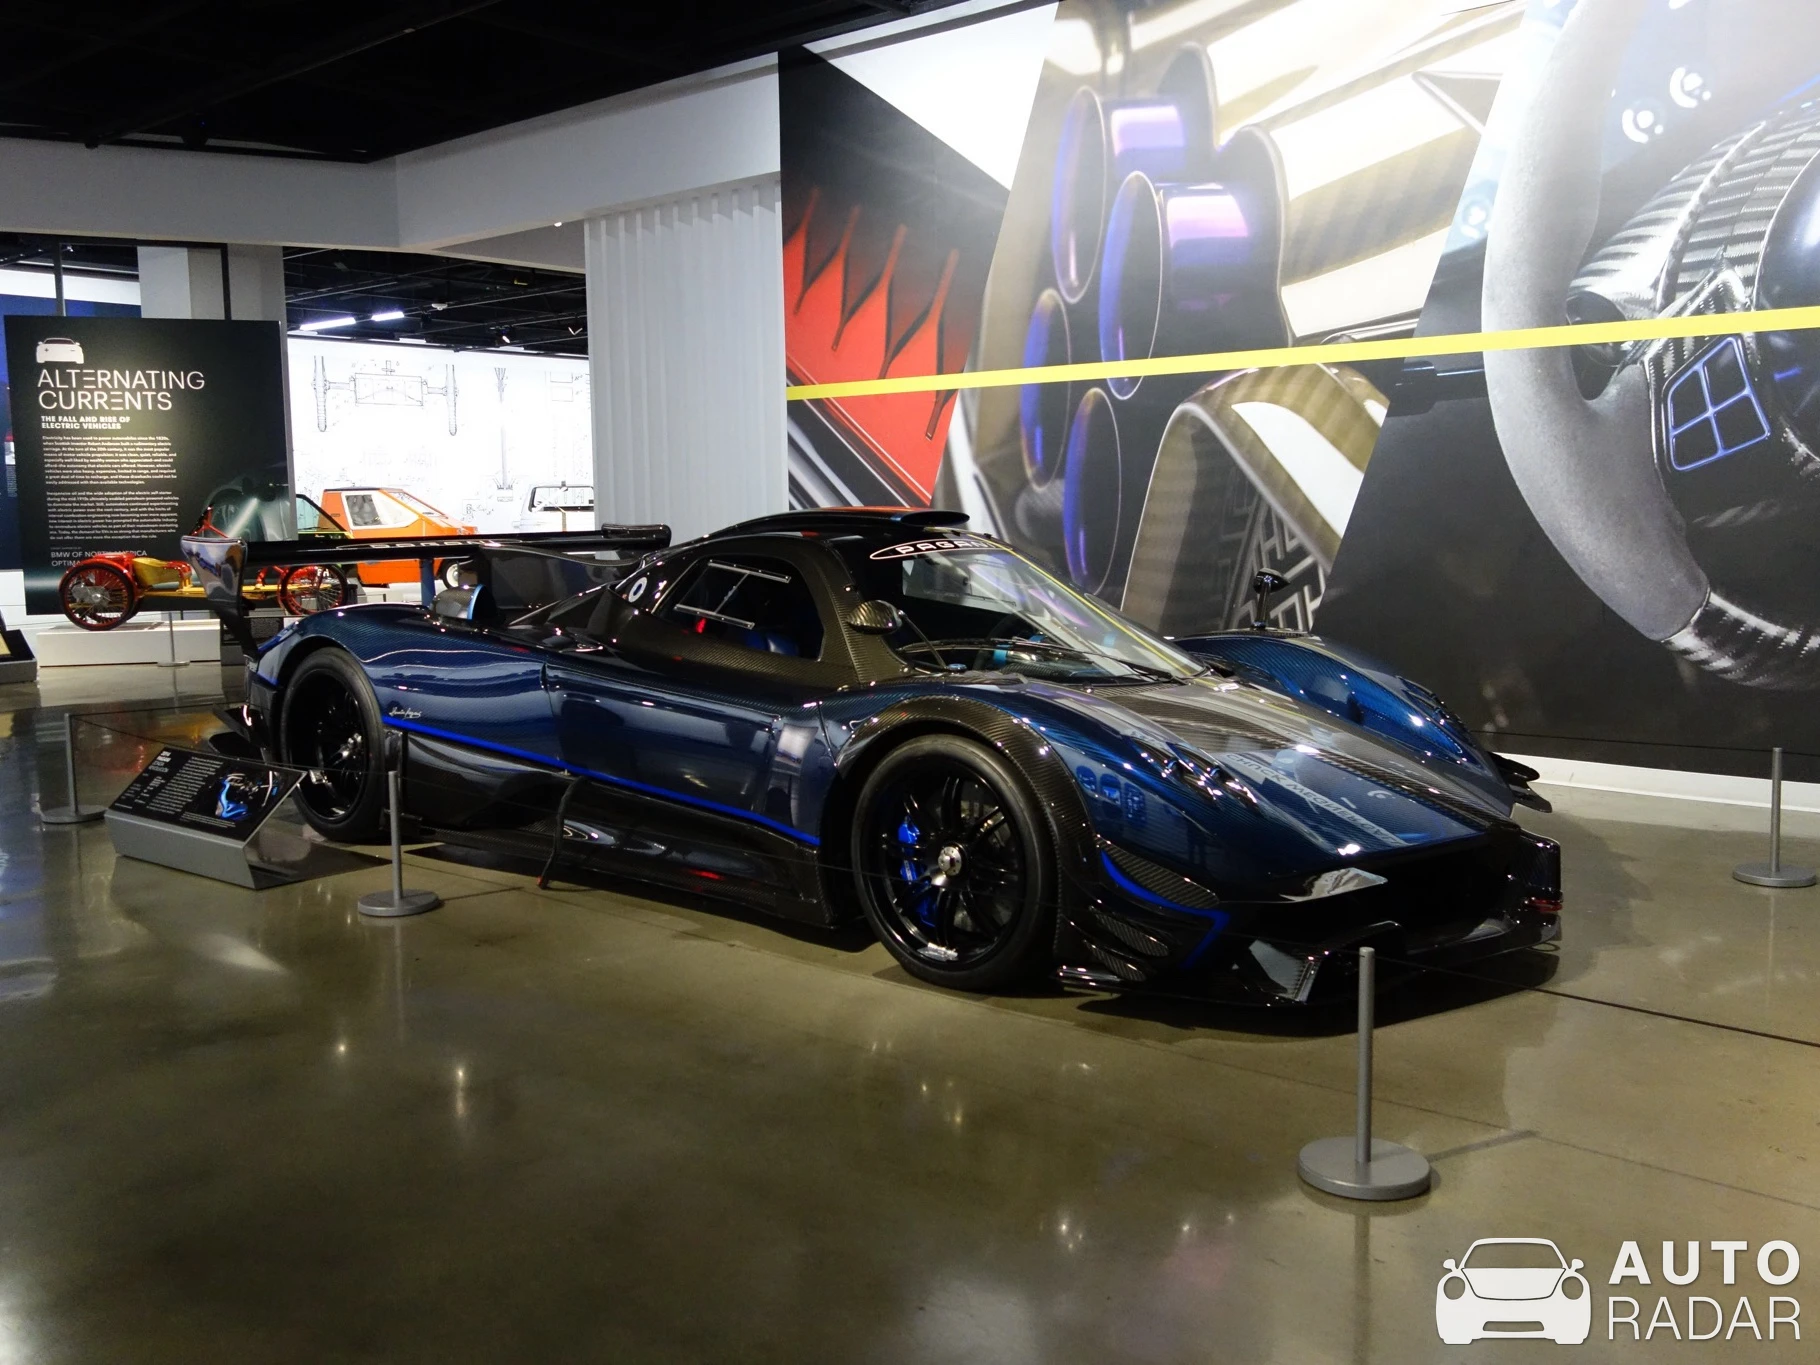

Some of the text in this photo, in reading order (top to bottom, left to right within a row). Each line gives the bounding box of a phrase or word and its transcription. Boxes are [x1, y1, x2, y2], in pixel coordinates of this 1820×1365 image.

[37, 369, 205, 390] ALTERNATING
[38, 390, 172, 411] CURRENTS
[82, 422, 122, 430] VEHICLES
